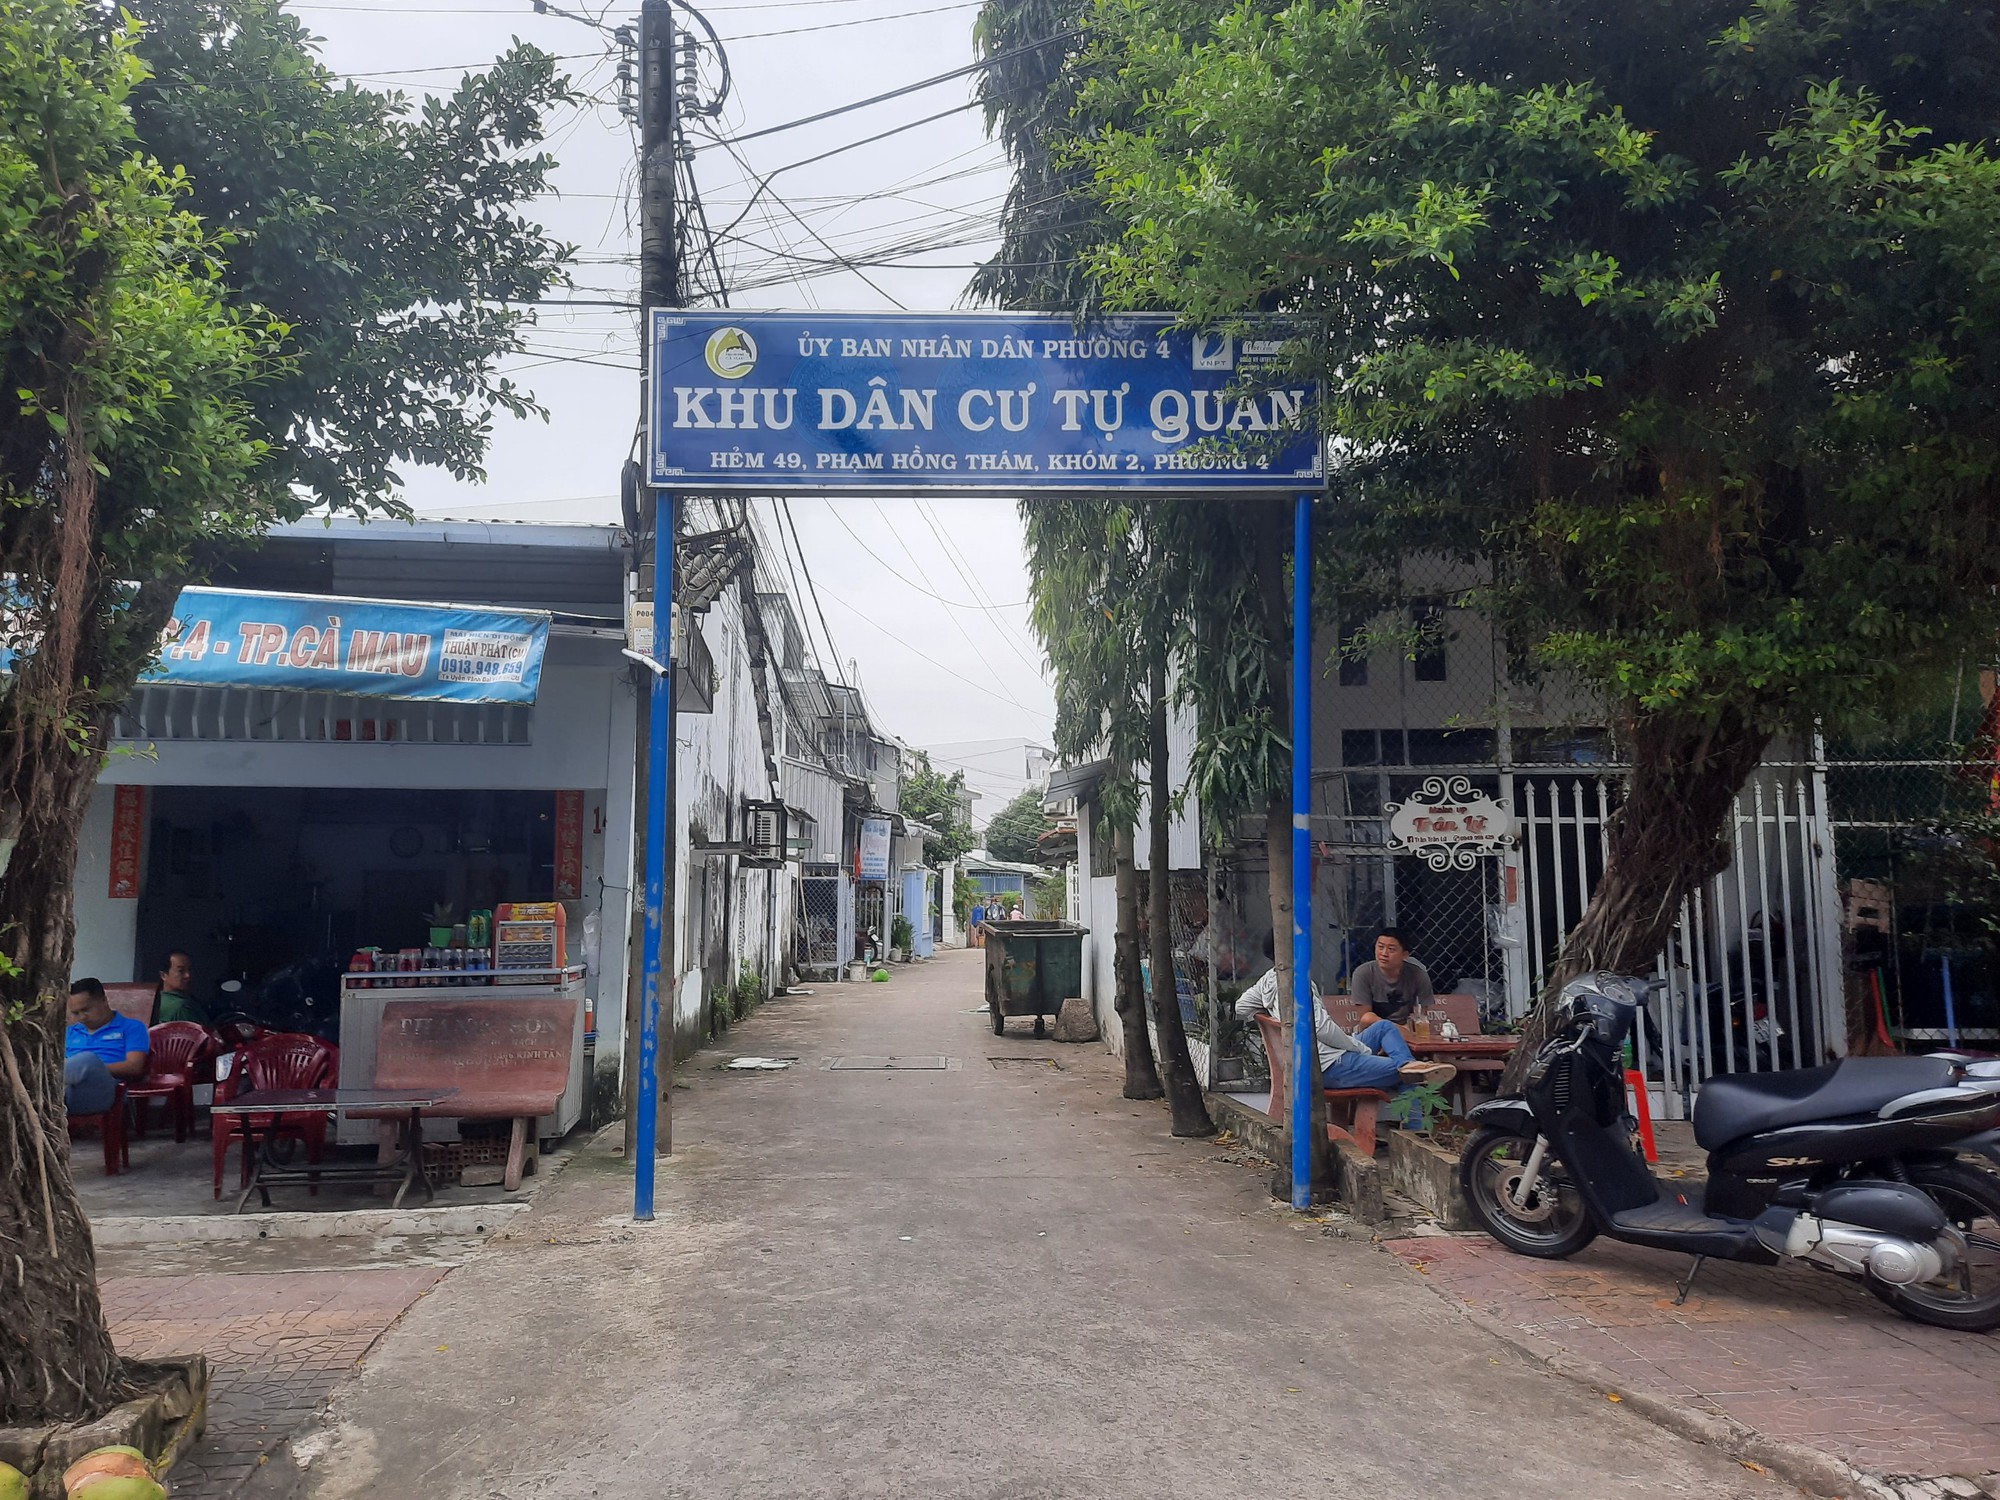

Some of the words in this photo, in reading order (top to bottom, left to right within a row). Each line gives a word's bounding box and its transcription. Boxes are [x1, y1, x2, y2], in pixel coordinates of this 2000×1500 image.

[798, 331, 833, 357] ỦY
[841, 338, 892, 357] BAN
[901, 334, 972, 358] NHÂN
[981, 334, 1034, 358] DÂN
[1043, 335, 1147, 359] PHƯỜNG
[1156, 340, 1170, 358] 4
[672, 387, 797, 430] KHU
[817, 376, 937, 431] DÂN
[958, 382, 1037, 431] CƯ
[1053, 382, 1130, 442] TỰ
[710, 446, 765, 468] HẺM
[773, 453, 807, 471] 49,
[816, 453, 883, 473] PHẠM
[891, 445, 958, 470] HỒNG
[965, 450, 1039, 472] THÁM,
[1048, 450, 1118, 470] KHÓM
[1126, 454, 1145, 472] 2,
[1255, 454, 1269, 470] 4
[238, 616, 341, 670] TP.CÀ
[345, 629, 431, 678] MAU
[444, 638, 478, 659] THUẬN
